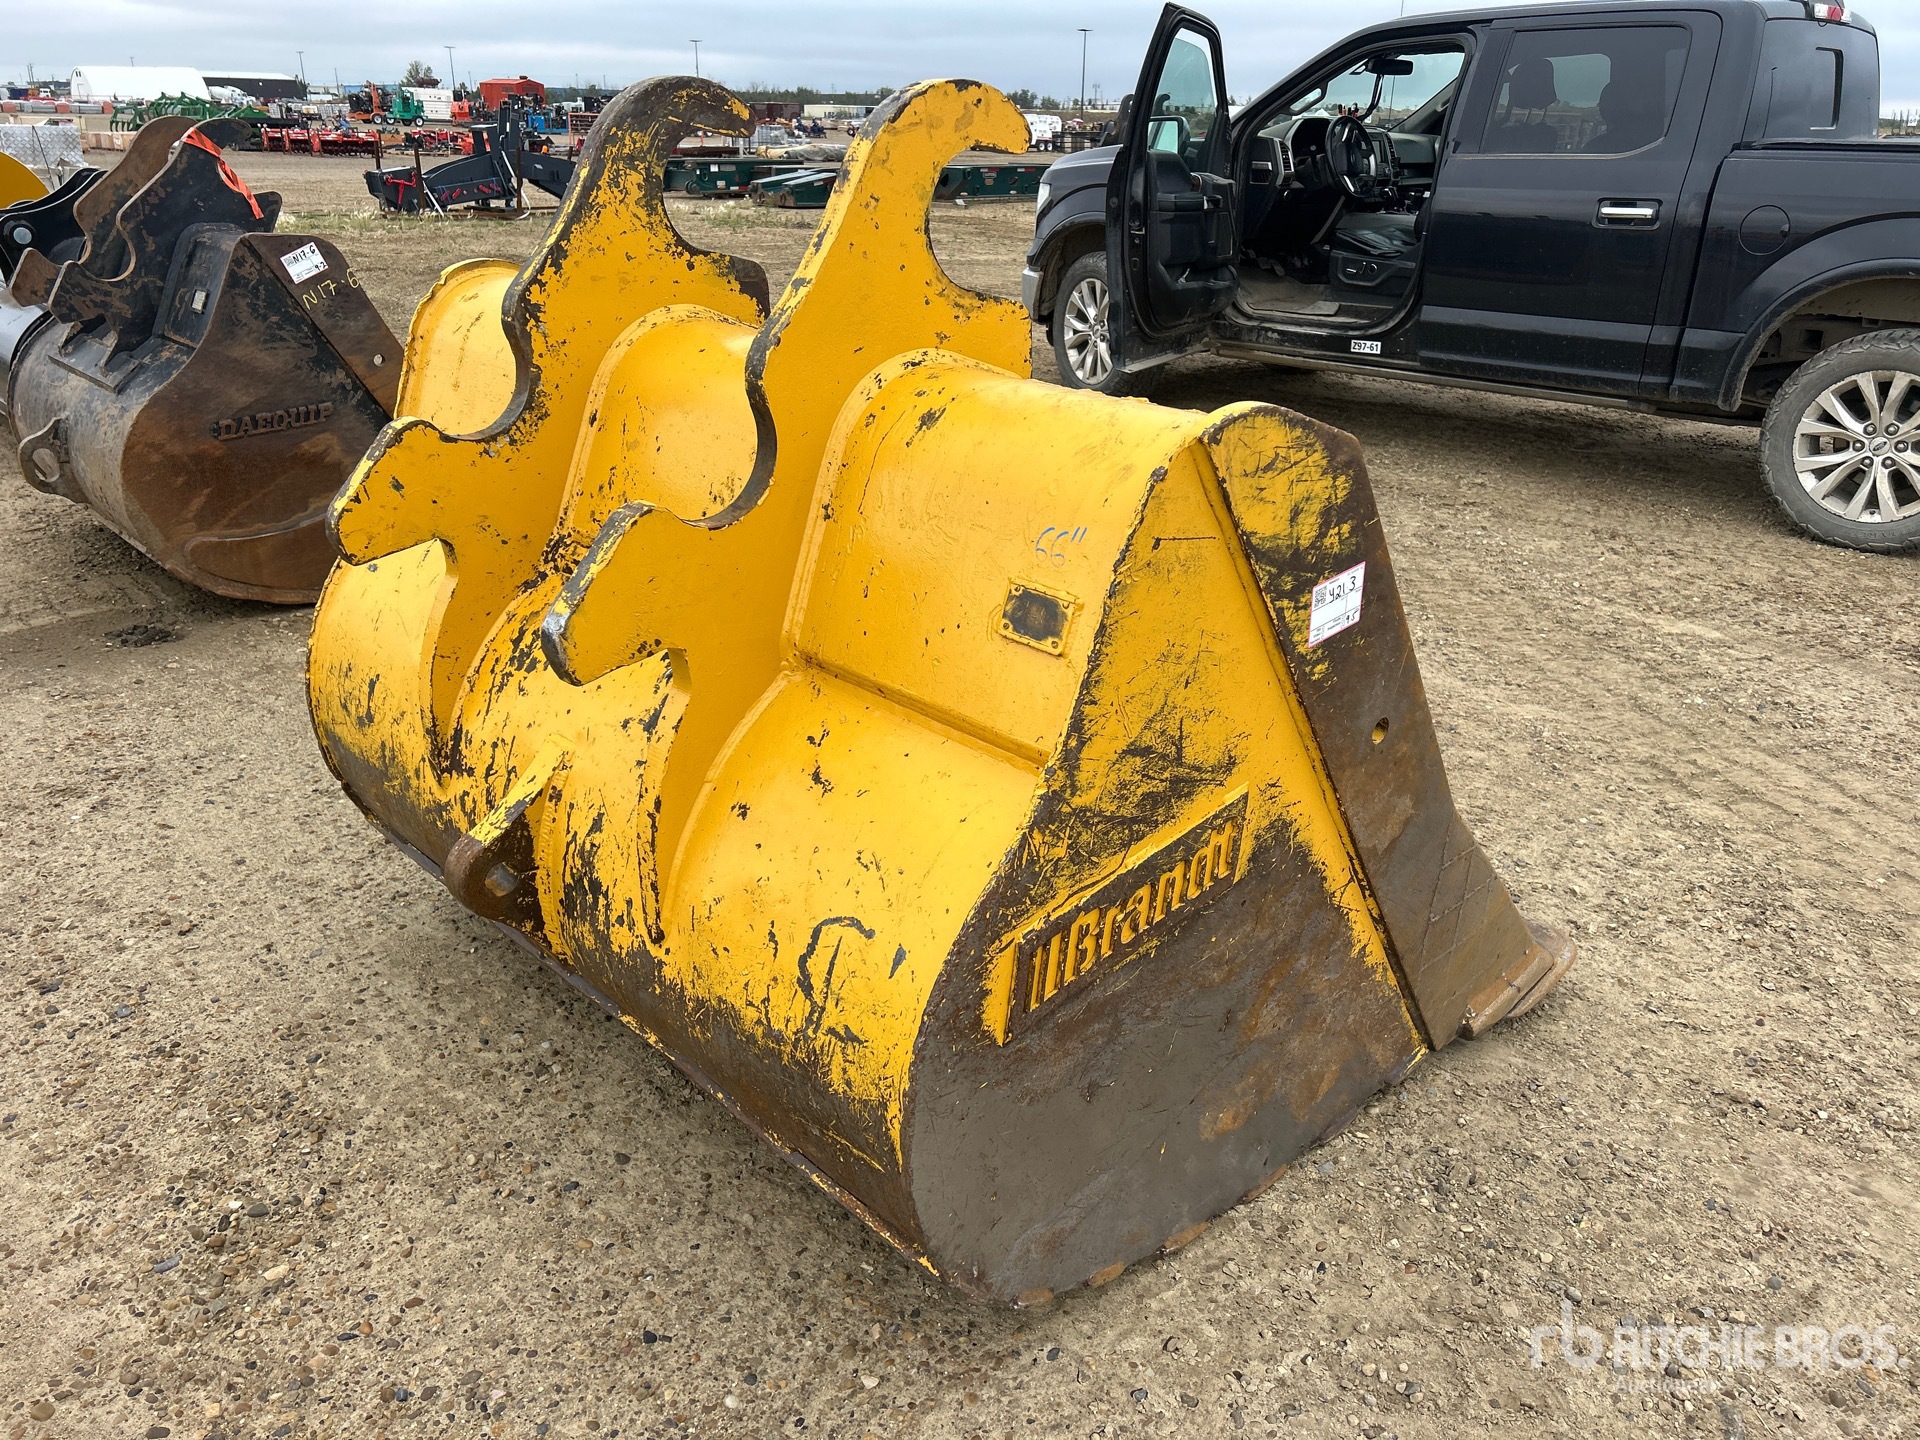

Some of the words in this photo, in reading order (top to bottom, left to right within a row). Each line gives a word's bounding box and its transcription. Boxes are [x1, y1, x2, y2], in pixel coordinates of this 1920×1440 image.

[1352, 341, 1379, 352] Z97-61
[216, 401, 335, 441] DAEQUIP
[1063, 819, 1237, 986] Brandt
